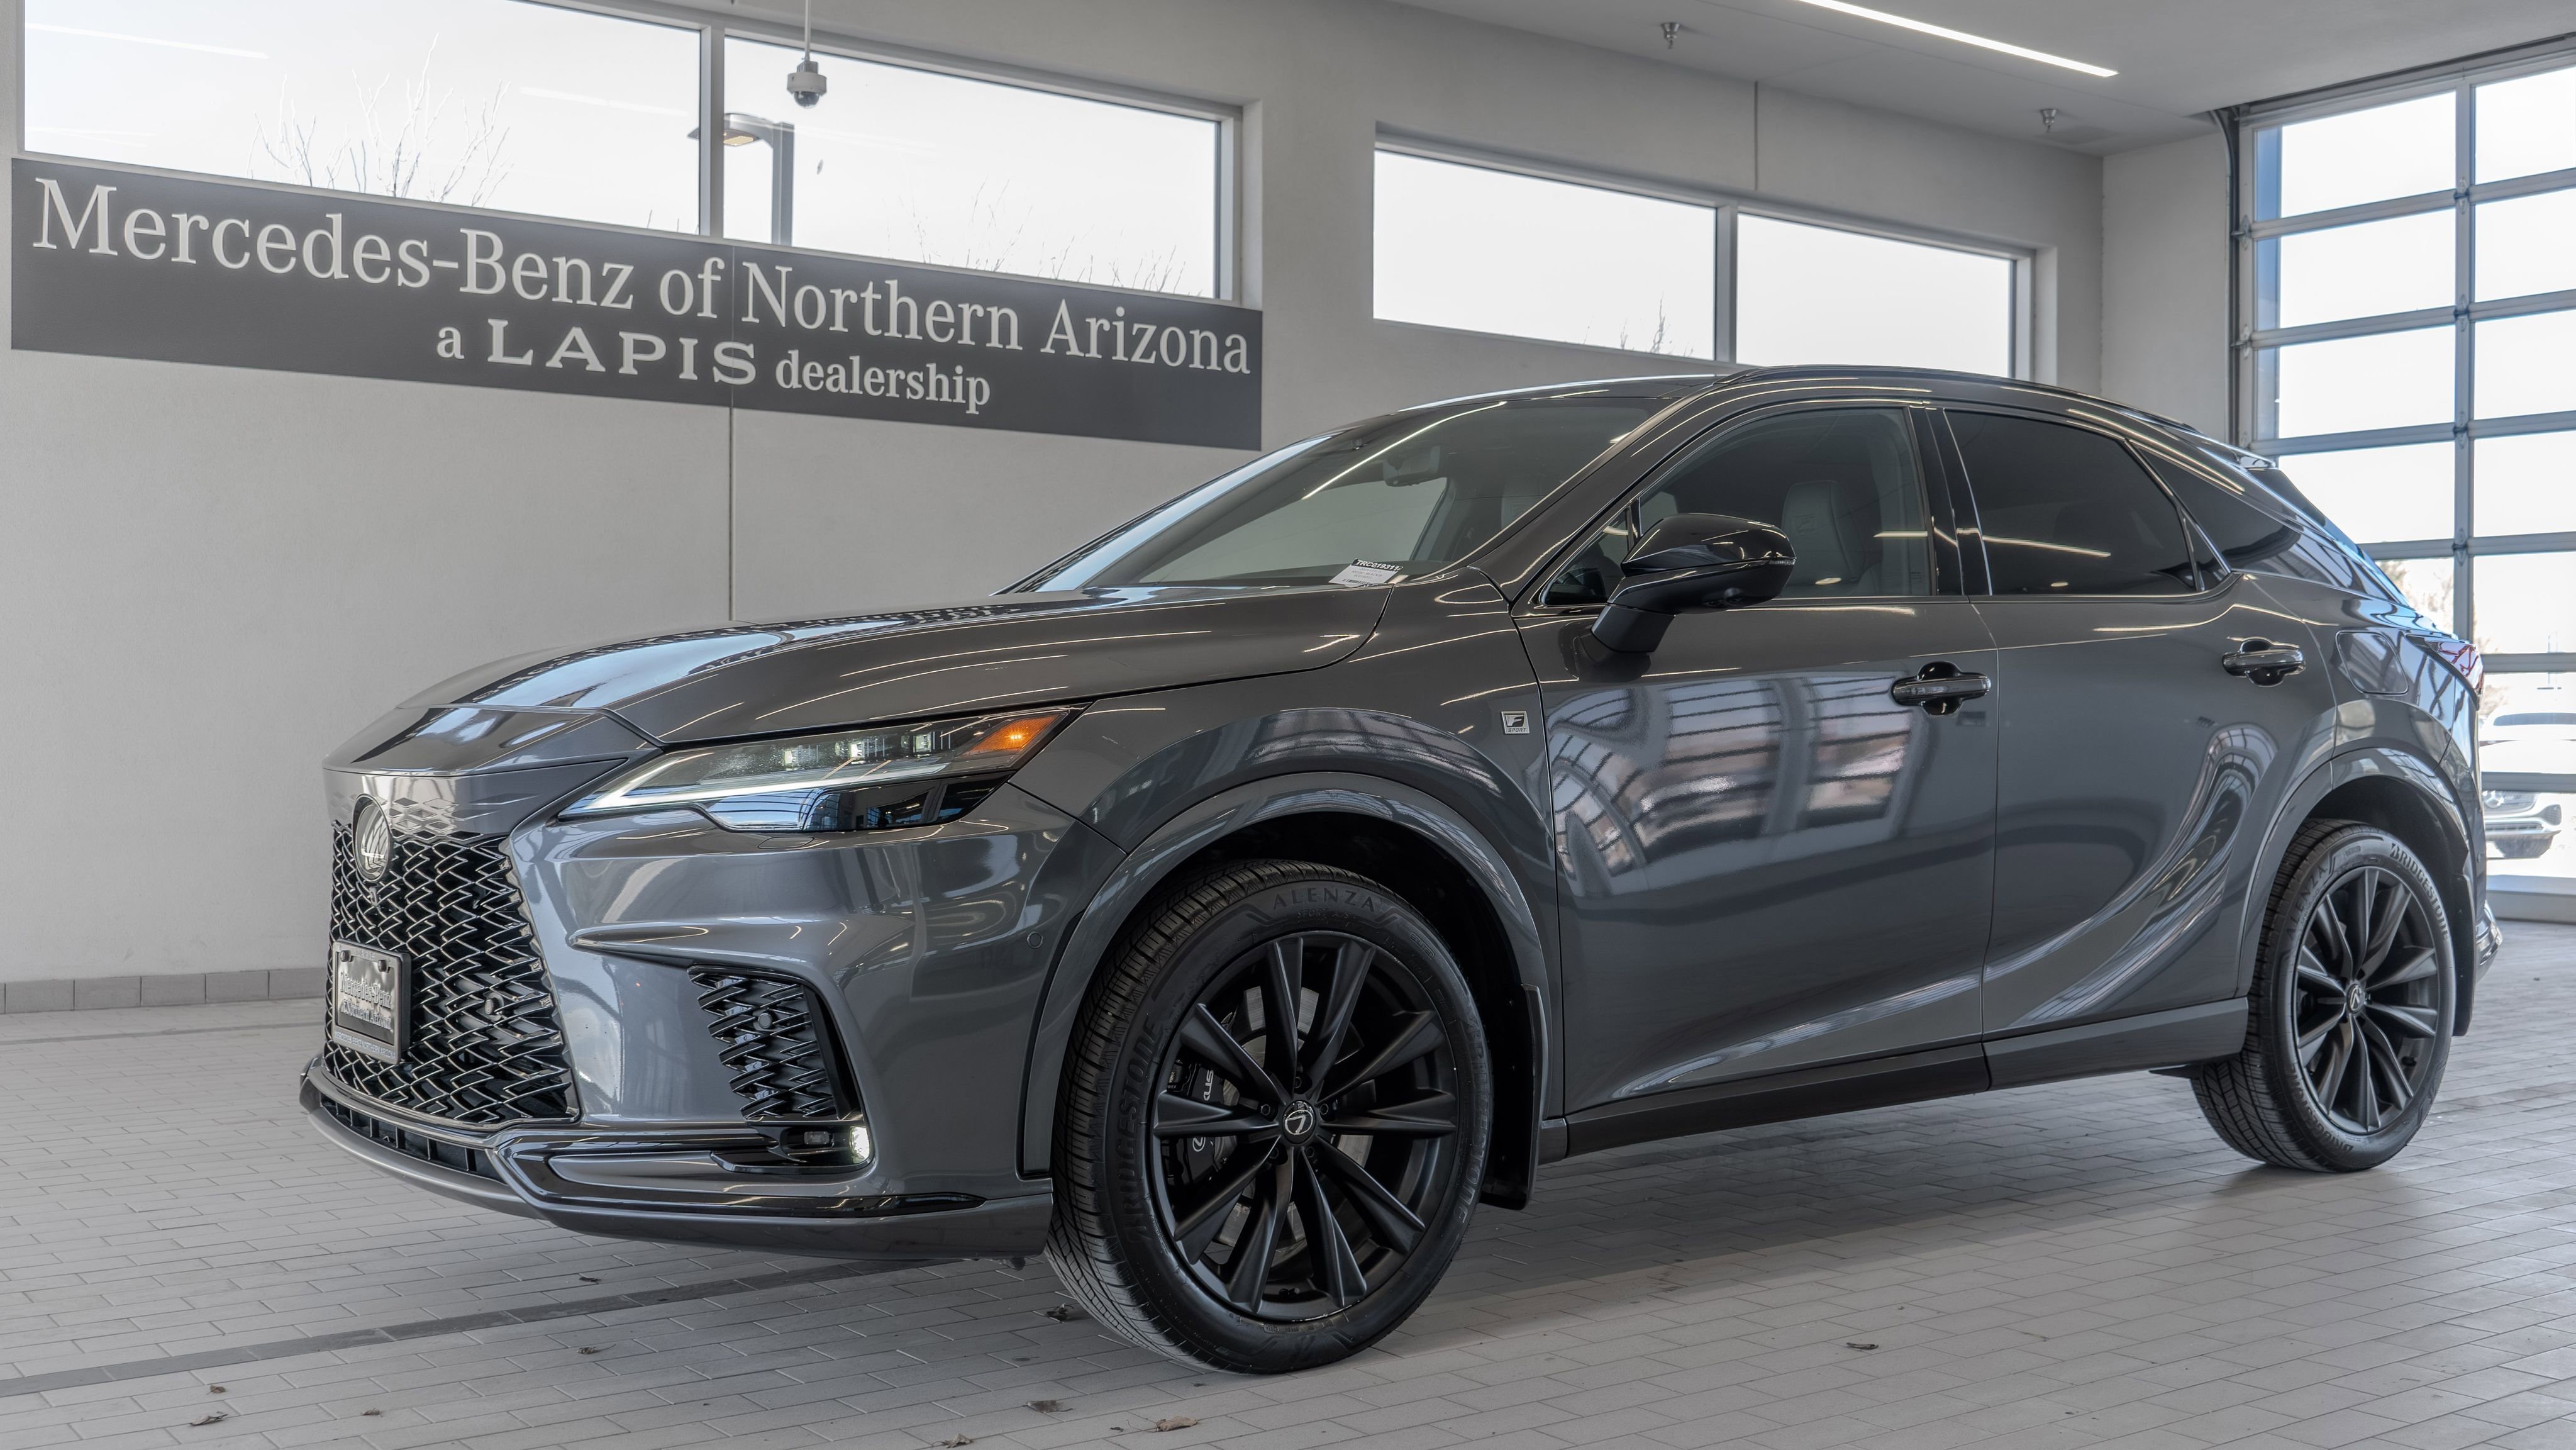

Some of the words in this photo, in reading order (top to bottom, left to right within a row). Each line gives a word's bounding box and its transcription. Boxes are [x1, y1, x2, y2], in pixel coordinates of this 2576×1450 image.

[33, 177, 634, 309] Mercedes-Benz
[660, 257, 724, 318] of
[742, 262, 1023, 352] Northern
[1041, 299, 1250, 374] Arizona
[437, 326, 464, 359] a
[488, 319, 755, 384] LAPIS
[776, 350, 989, 414] dealership
[1274, 887, 1375, 912] ALENZA
[2286, 866, 2328, 940] ALENZA
[2390, 843, 2449, 942] BRIDGESTONE
[340, 971, 391, 1009] Mercedes-Benz
[1116, 1016, 1161, 1242] BRIDGESTONE
